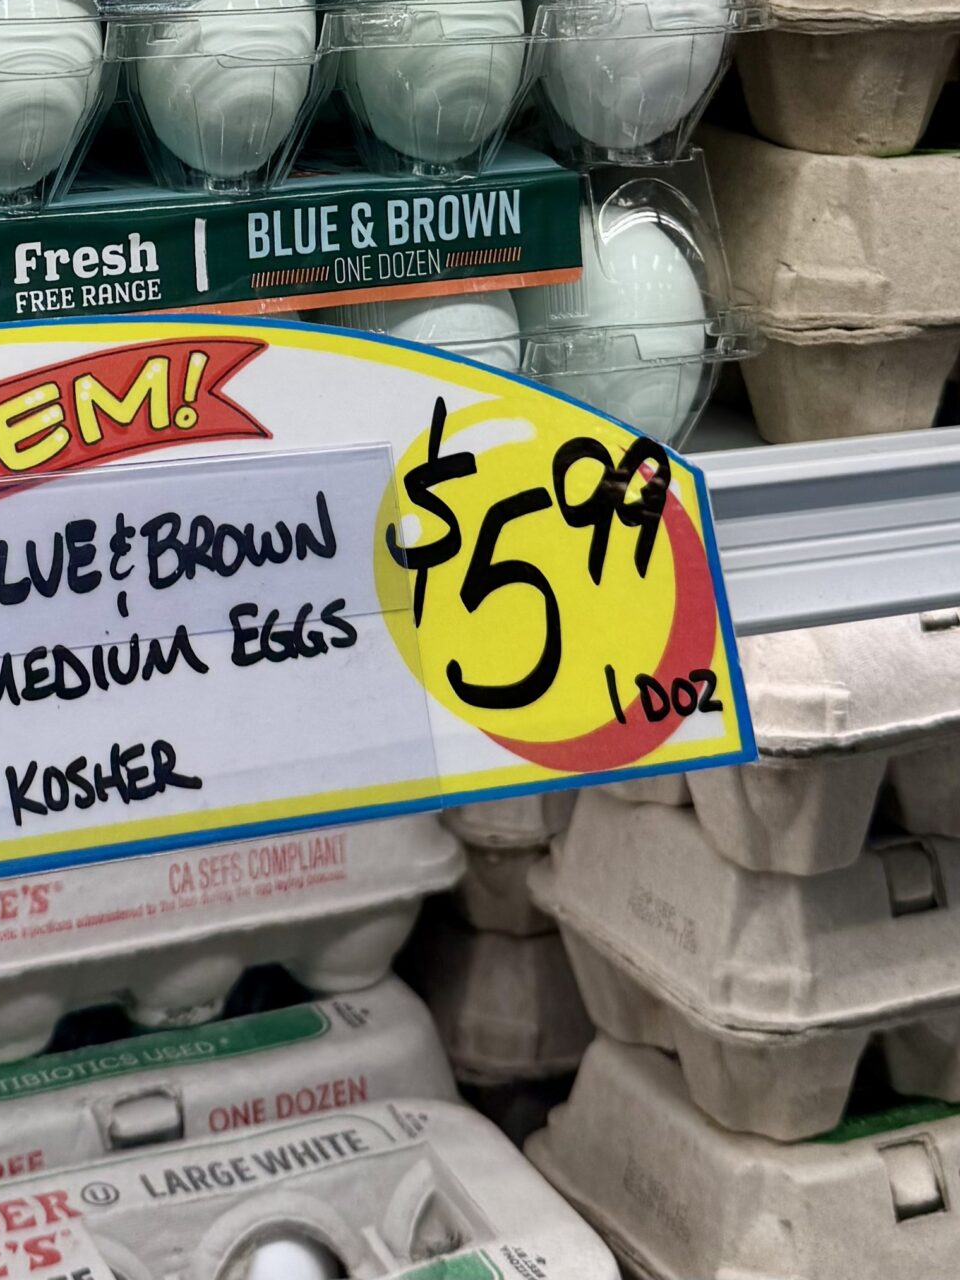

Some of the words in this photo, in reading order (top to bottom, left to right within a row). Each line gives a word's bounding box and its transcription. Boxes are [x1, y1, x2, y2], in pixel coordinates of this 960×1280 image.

[247, 204, 341, 260] BLUE
[350, 201, 378, 250] &
[386, 189, 522, 247] BROWN
[13, 232, 160, 285] Fresh
[334, 253, 374, 285] ONE
[378, 249, 441, 279] DOZEN
[15, 286, 75, 314] FREE
[81, 278, 162, 308] RANGE
[230, 598, 357, 667] EGGS
[604, 664, 627, 724] 1
[635, 668, 724, 723] DOZ
[5, 739, 203, 826] KOSHER
[168, 863, 195, 895] CA
[248, 833, 348, 879] COMPLIANT
[144, 1039, 216, 1062] USED
[208, 1097, 265, 1133] ONE
[275, 1074, 368, 1120] DOZEN
[140, 1158, 257, 1199] LARGE
[251, 1129, 370, 1175] WHITE
